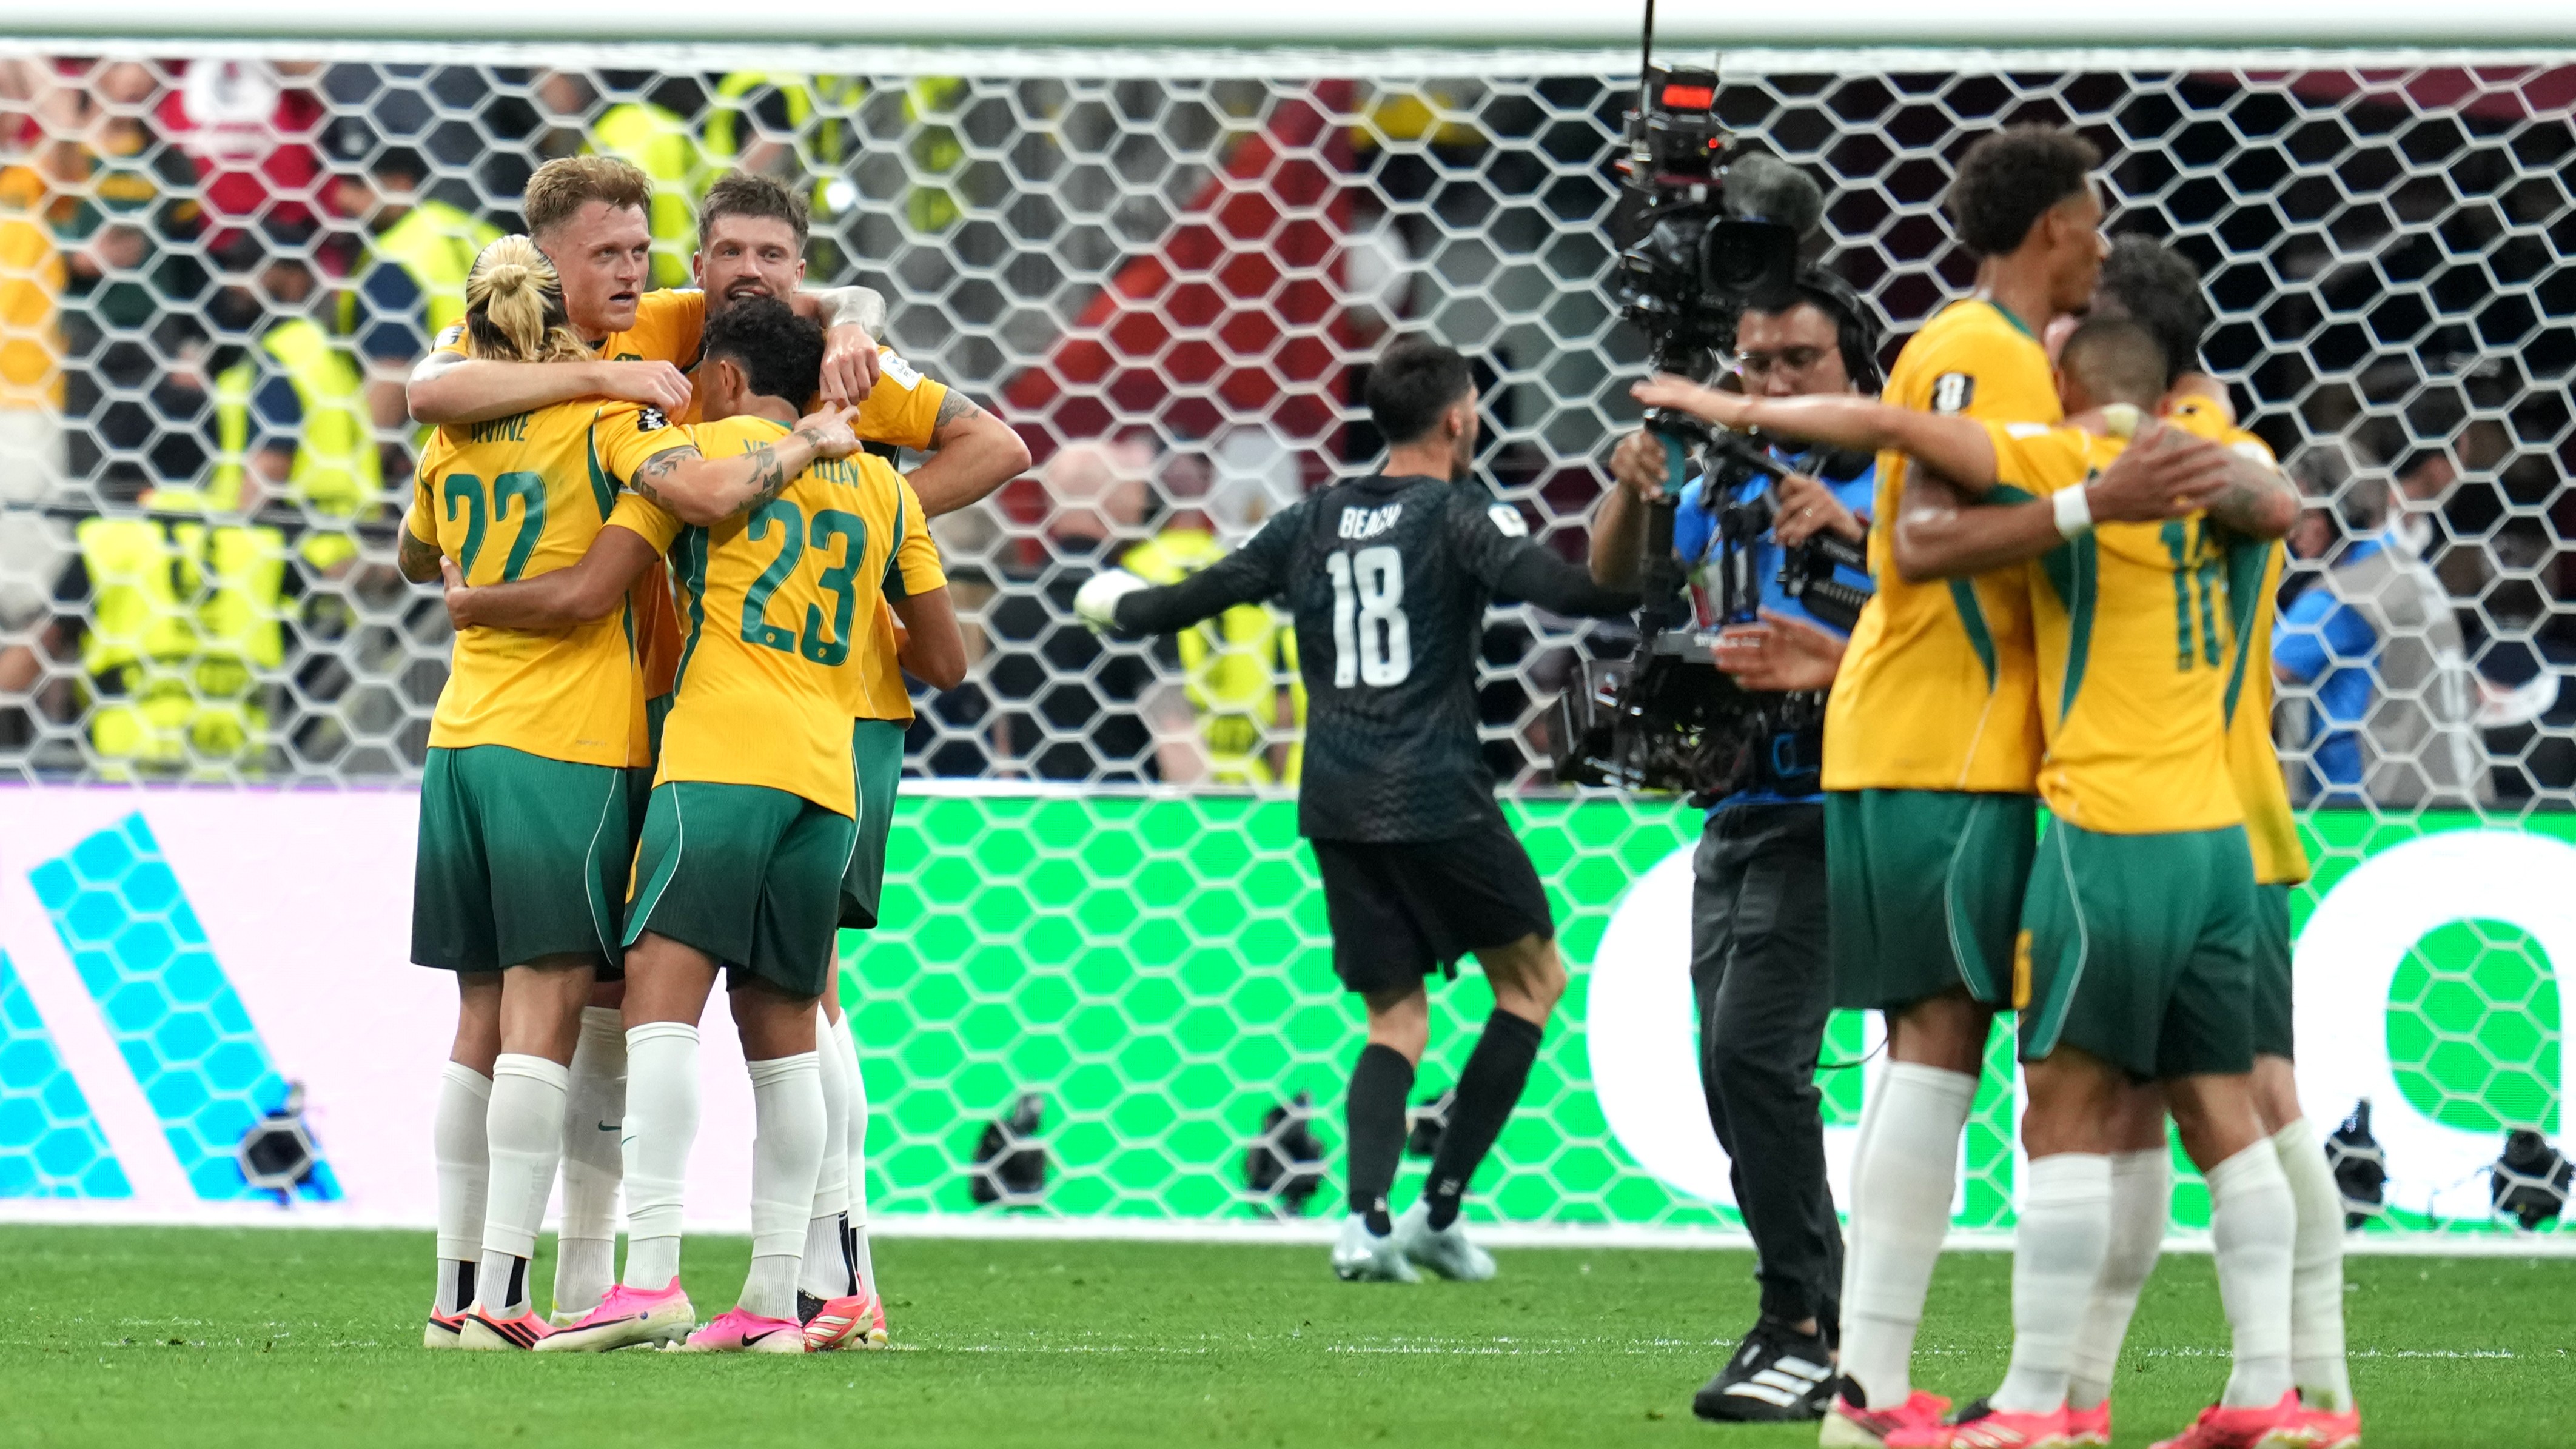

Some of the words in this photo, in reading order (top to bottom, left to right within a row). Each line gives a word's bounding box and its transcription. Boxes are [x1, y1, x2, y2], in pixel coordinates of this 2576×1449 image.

[444, 471, 548, 583] 22
[740, 498, 868, 666] 23
[1338, 503, 1403, 539] BEACH
[1326, 546, 1412, 688] 18
